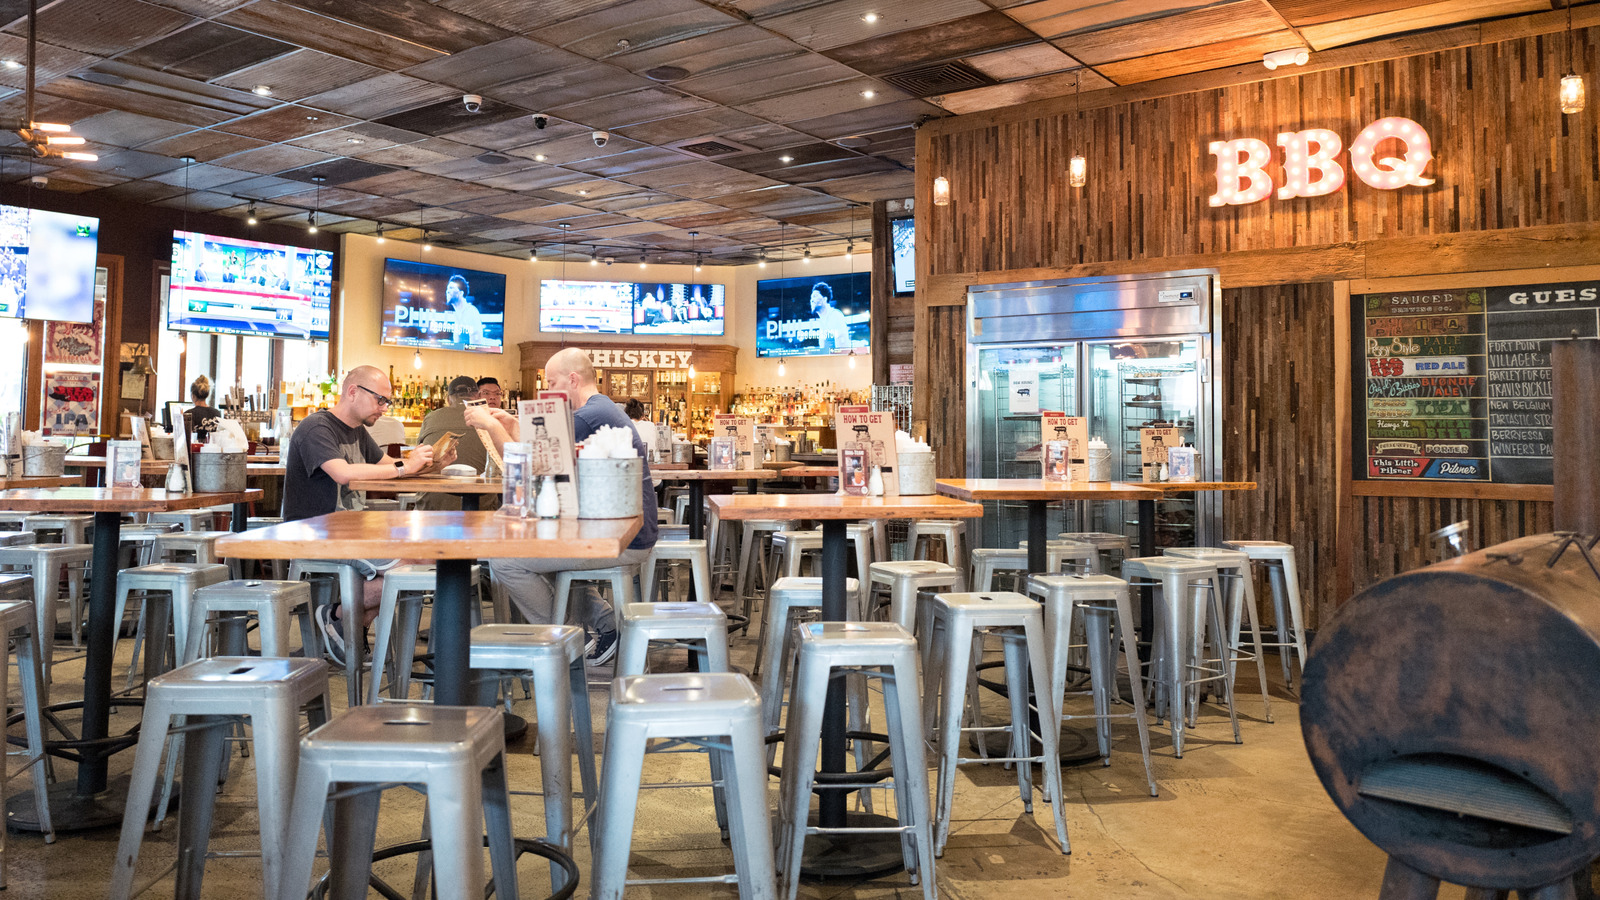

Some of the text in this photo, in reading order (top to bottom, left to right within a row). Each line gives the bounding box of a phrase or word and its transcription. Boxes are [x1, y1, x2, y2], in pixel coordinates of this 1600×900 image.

[1208, 116, 1436, 207] BBQ
[1391, 294, 1453, 305] SAUCED
[1423, 336, 1461, 346] PALE
[1427, 345, 1457, 355] ALE
[1488, 341, 1541, 353] FORT POINT
[583, 349, 692, 368] HISKEY
[1415, 361, 1466, 371] RED ALE
[1489, 369, 1552, 382] BARLEY FORGE
[1421, 377, 1476, 387] BLONDE
[1434, 387, 1460, 396] ALE
[1489, 383, 1521, 397] TRAVIS
[1490, 400, 1551, 411] NEW BELGIUM
[843, 414, 882, 424] HOW TO GET
[1047, 418, 1059, 426] HOW
[1425, 419, 1471, 428] WHEAT
[1425, 428, 1472, 439] BEER
[1491, 430, 1544, 441] BERRYESSA
[1425, 444, 1469, 454] PORTER
[1394, 459, 1419, 467] Little
[1379, 467, 1412, 475] Pilsner
[1440, 462, 1477, 475] Pilsner
